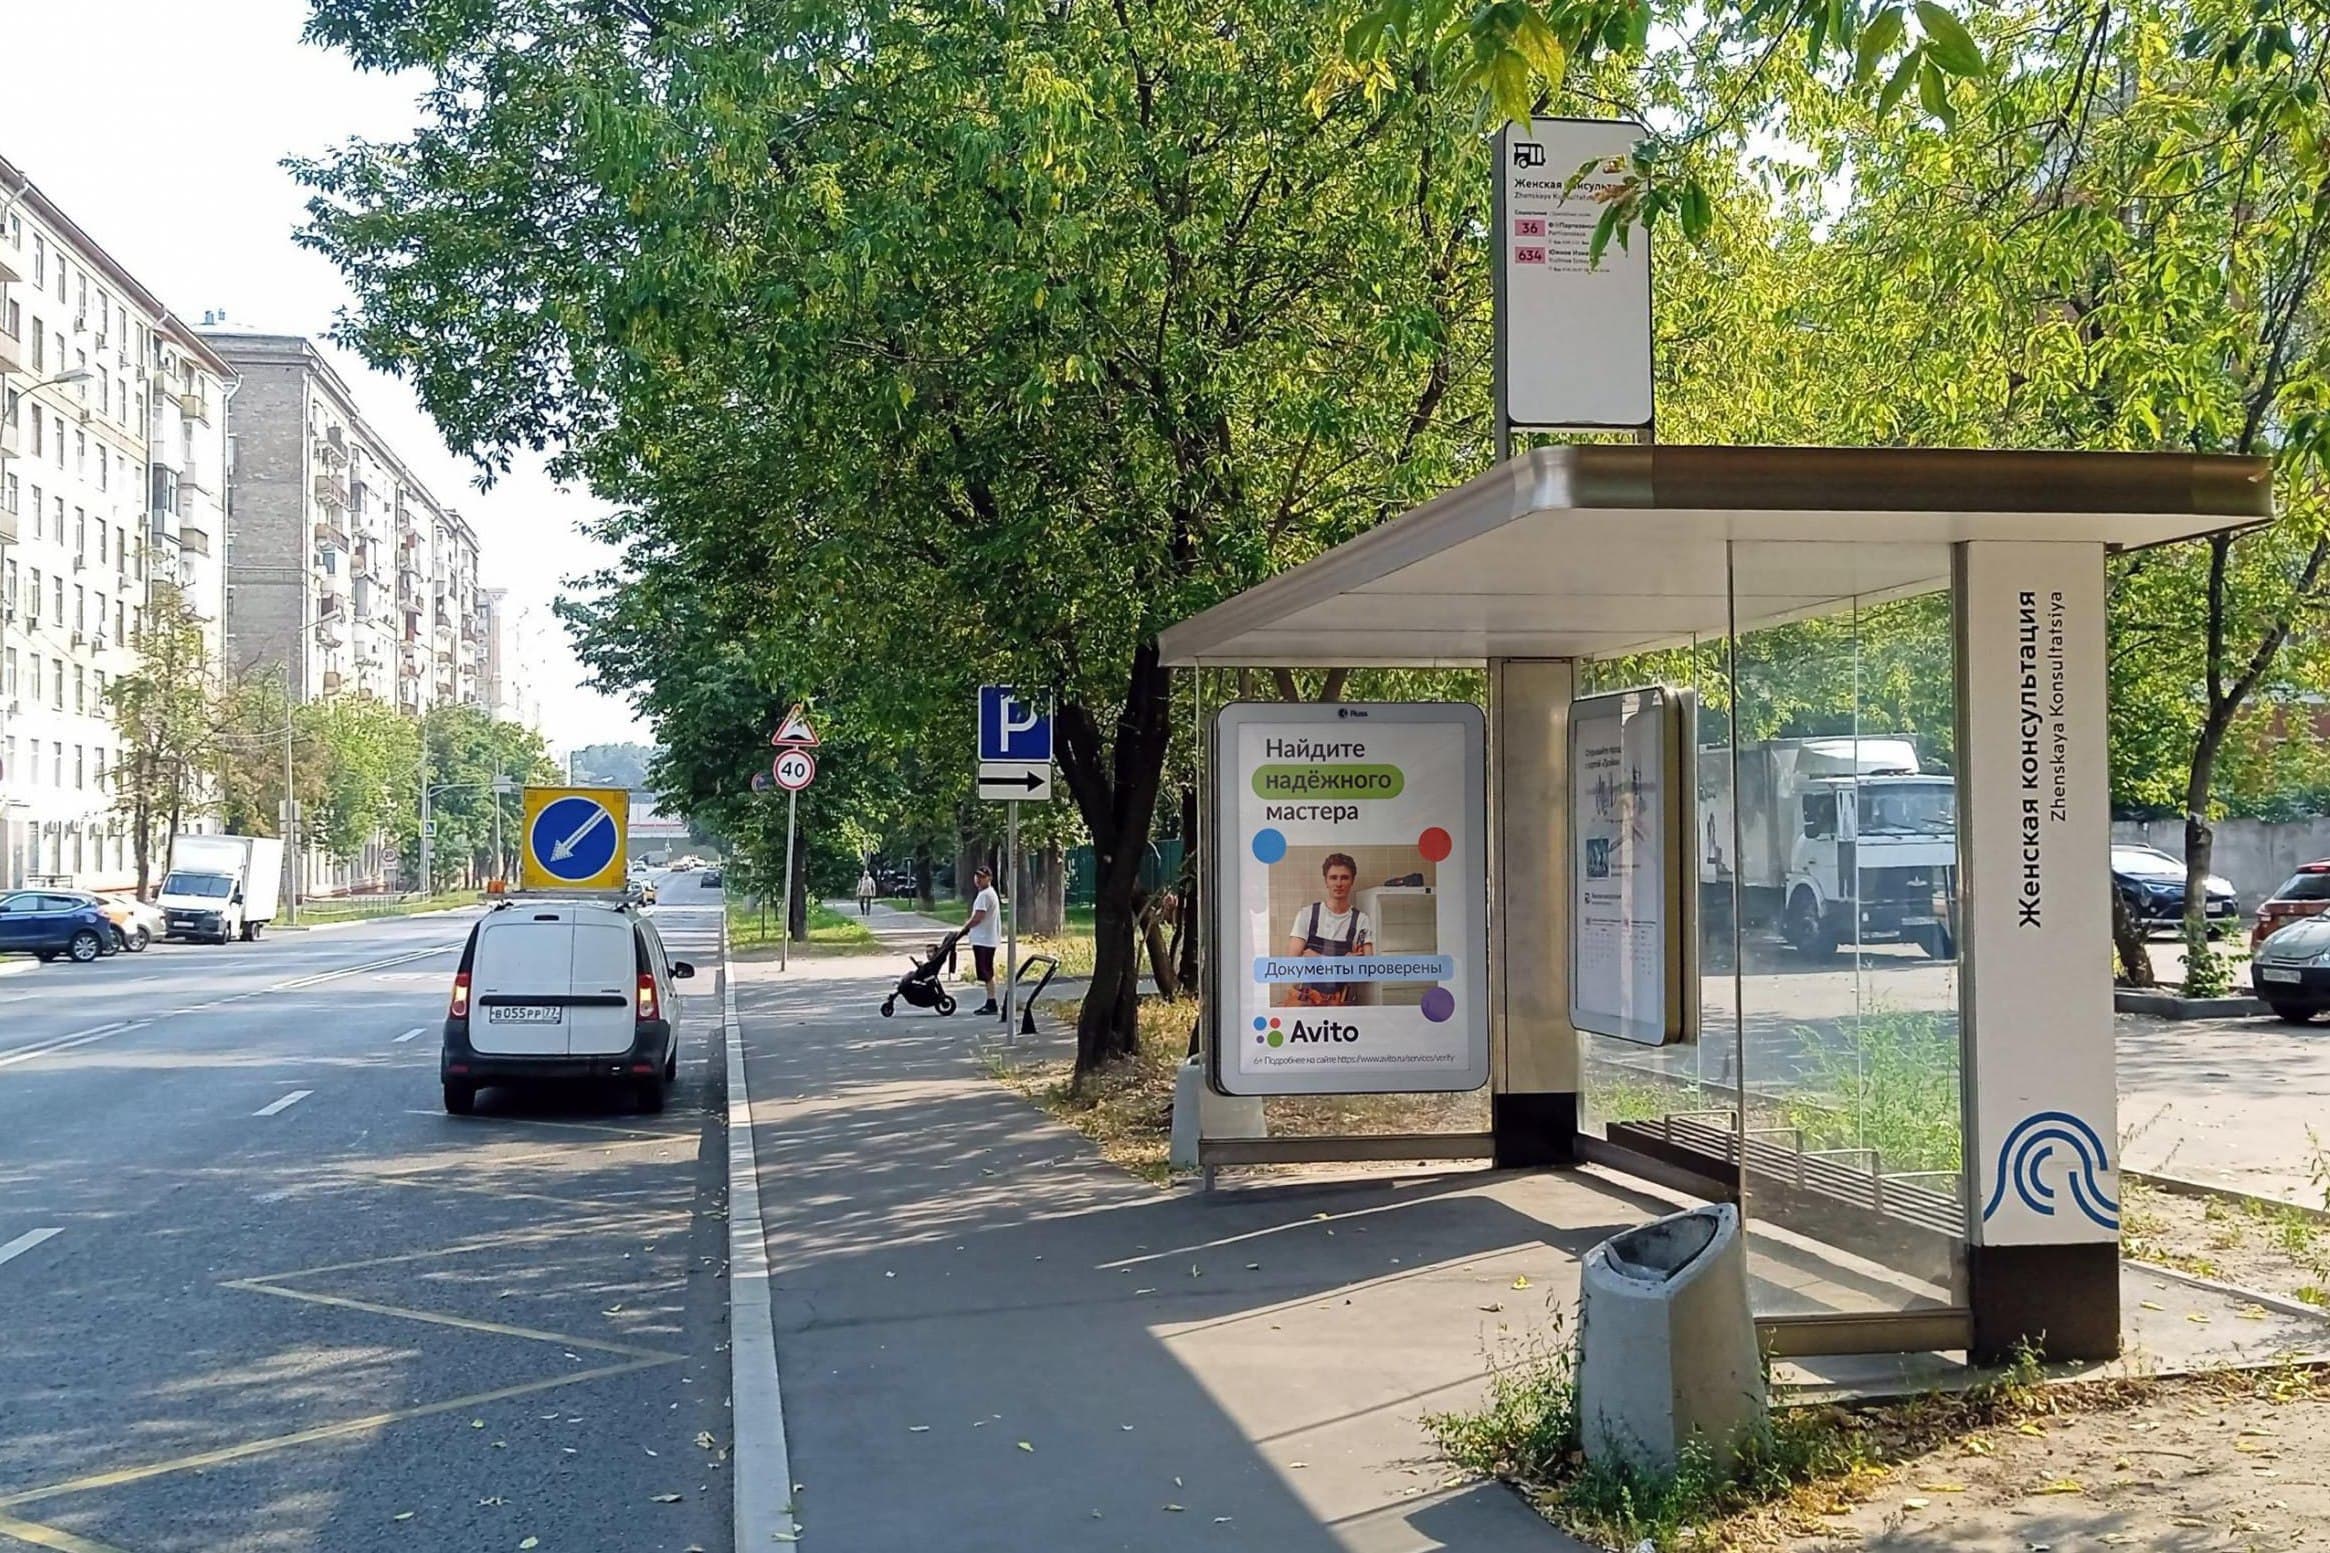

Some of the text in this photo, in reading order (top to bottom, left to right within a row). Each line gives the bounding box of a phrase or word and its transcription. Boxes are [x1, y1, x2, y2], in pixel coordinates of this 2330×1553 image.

[1514, 178, 1562, 190] Женская
[1521, 222, 1539, 234] 36
[1517, 249, 1543, 262] 634
[2047, 591, 2068, 822] Zhenskaya Konsultatsiya
[1266, 738, 1366, 762] Найдите
[2018, 591, 2044, 928] Женская консультация
[781, 762, 806, 778] 40
[1266, 769, 1392, 793] надёжного
[1266, 804, 1359, 824] мастера
[1264, 962, 1443, 979] Документы проверены
[1289, 1019, 1360, 1044] Avito
